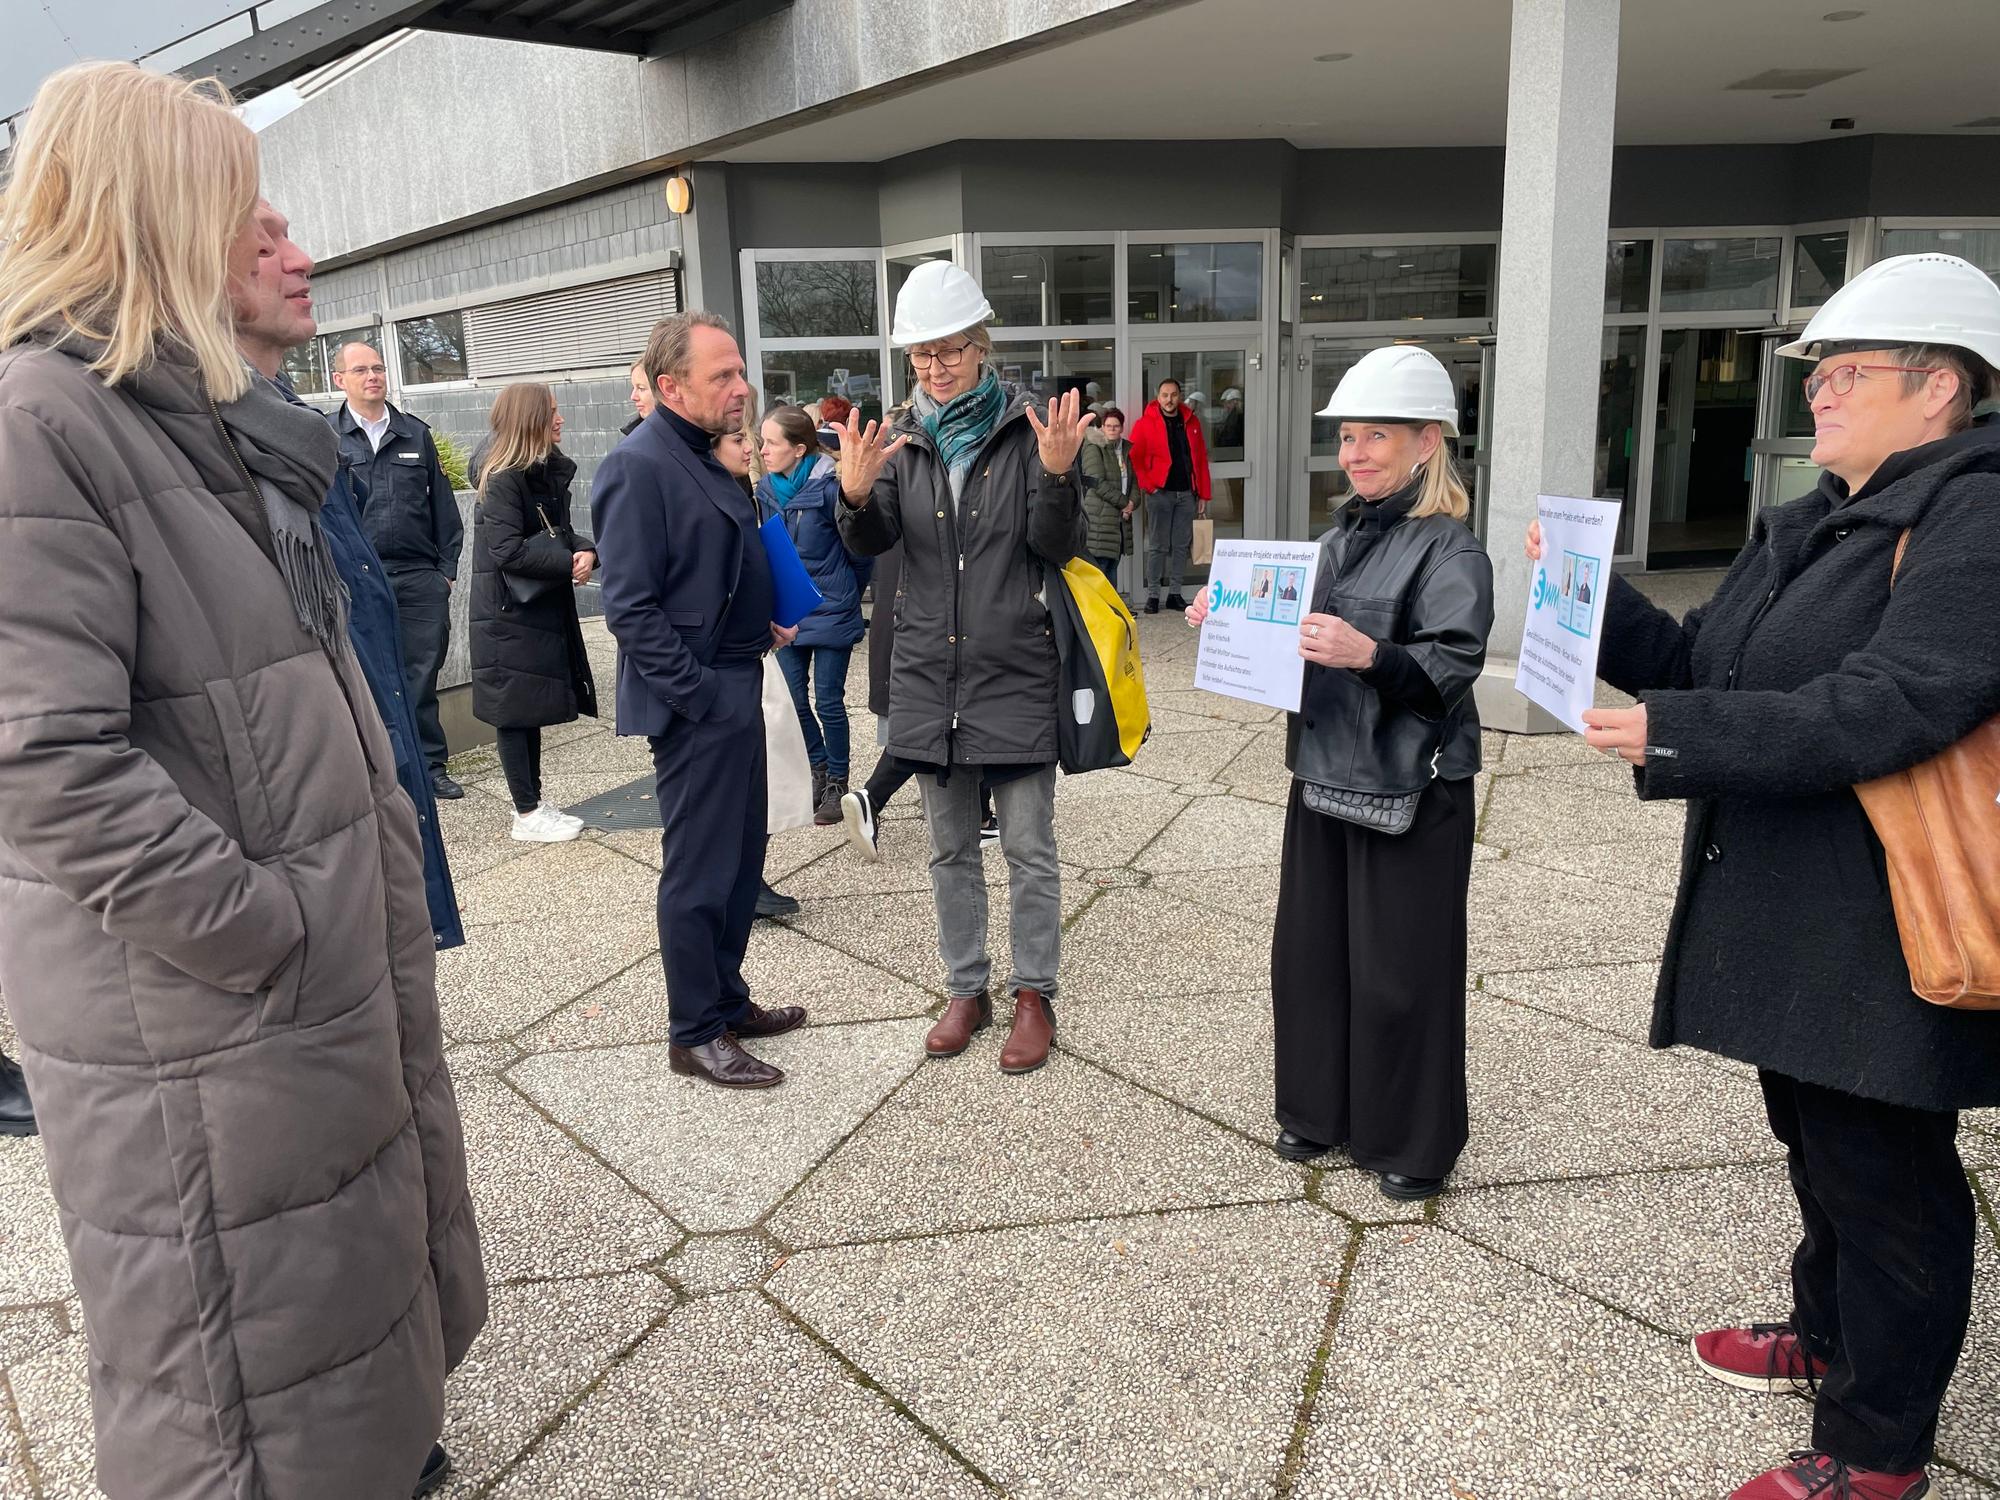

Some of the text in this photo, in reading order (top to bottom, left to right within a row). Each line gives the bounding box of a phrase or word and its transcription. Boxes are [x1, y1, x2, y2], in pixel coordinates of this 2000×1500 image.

[1585, 515, 1604, 526] werden?
[1253, 550, 1272, 561] Projekte
[1272, 551, 1291, 560] verkauft
[1291, 552, 1315, 562] werden?
[1209, 580, 1248, 613] SWM
